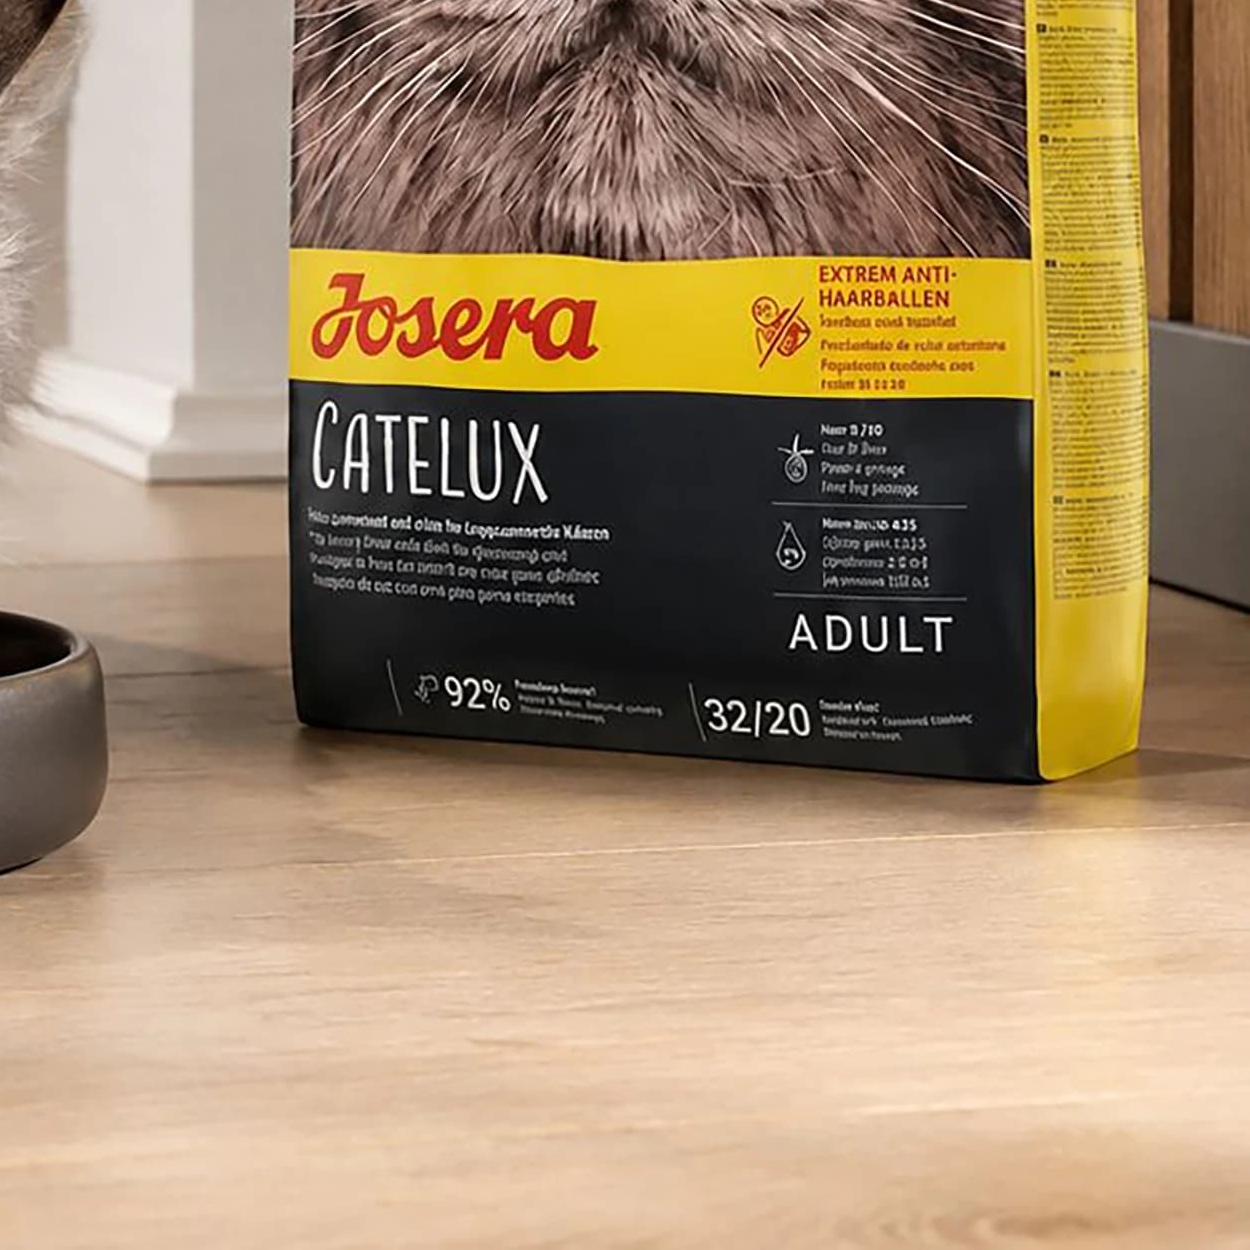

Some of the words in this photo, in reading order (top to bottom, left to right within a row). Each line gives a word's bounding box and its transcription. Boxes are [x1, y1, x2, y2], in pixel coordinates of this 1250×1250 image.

[819, 265, 896, 283] EXTREM
[312, 273, 599, 361] Josera
[819, 289, 950, 308] HAARBALLEN
[312, 400, 549, 505] CATELUX
[788, 613, 954, 653] ADULT
[444, 675, 512, 712] 92%
[704, 698, 811, 738] 32/20
